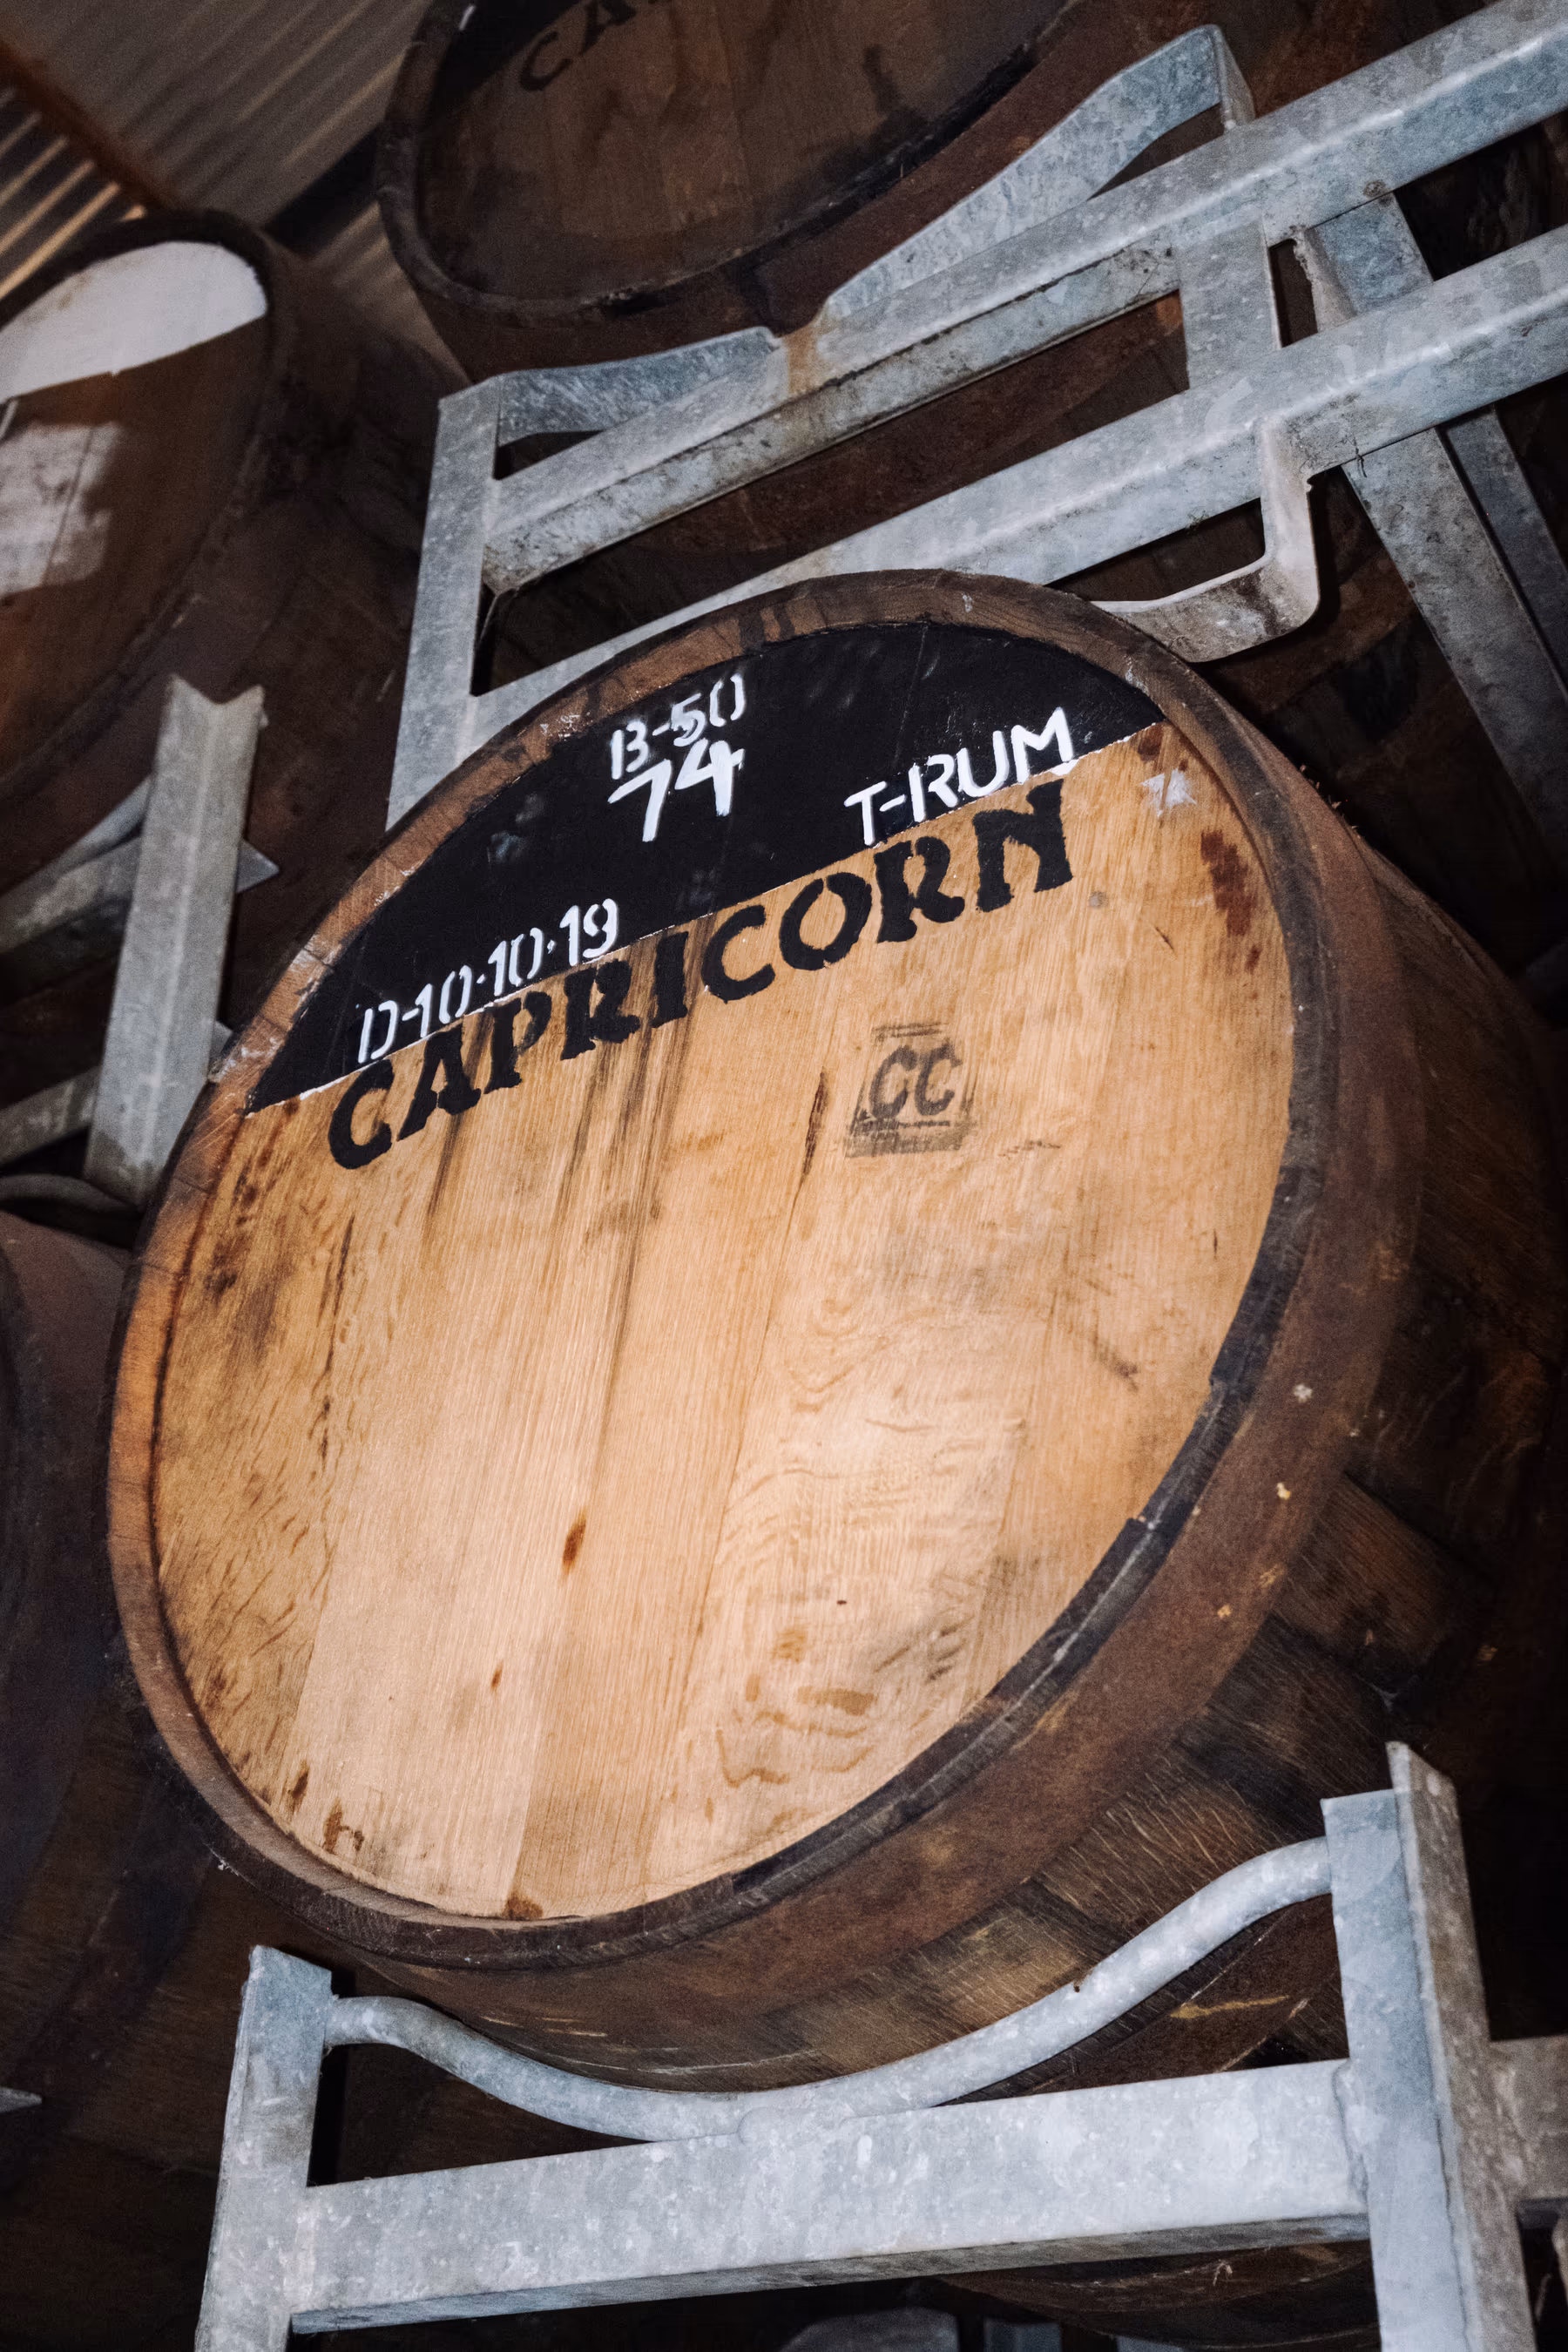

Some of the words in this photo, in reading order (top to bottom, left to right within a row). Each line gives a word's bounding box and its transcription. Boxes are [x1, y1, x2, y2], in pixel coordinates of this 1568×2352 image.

[611, 672, 747, 781] B-50
[844, 706, 1074, 847] T-RUM
[607, 737, 746, 842] 74
[328, 779, 1074, 1170] CAPRICORN
[868, 1043, 963, 1119] CC
